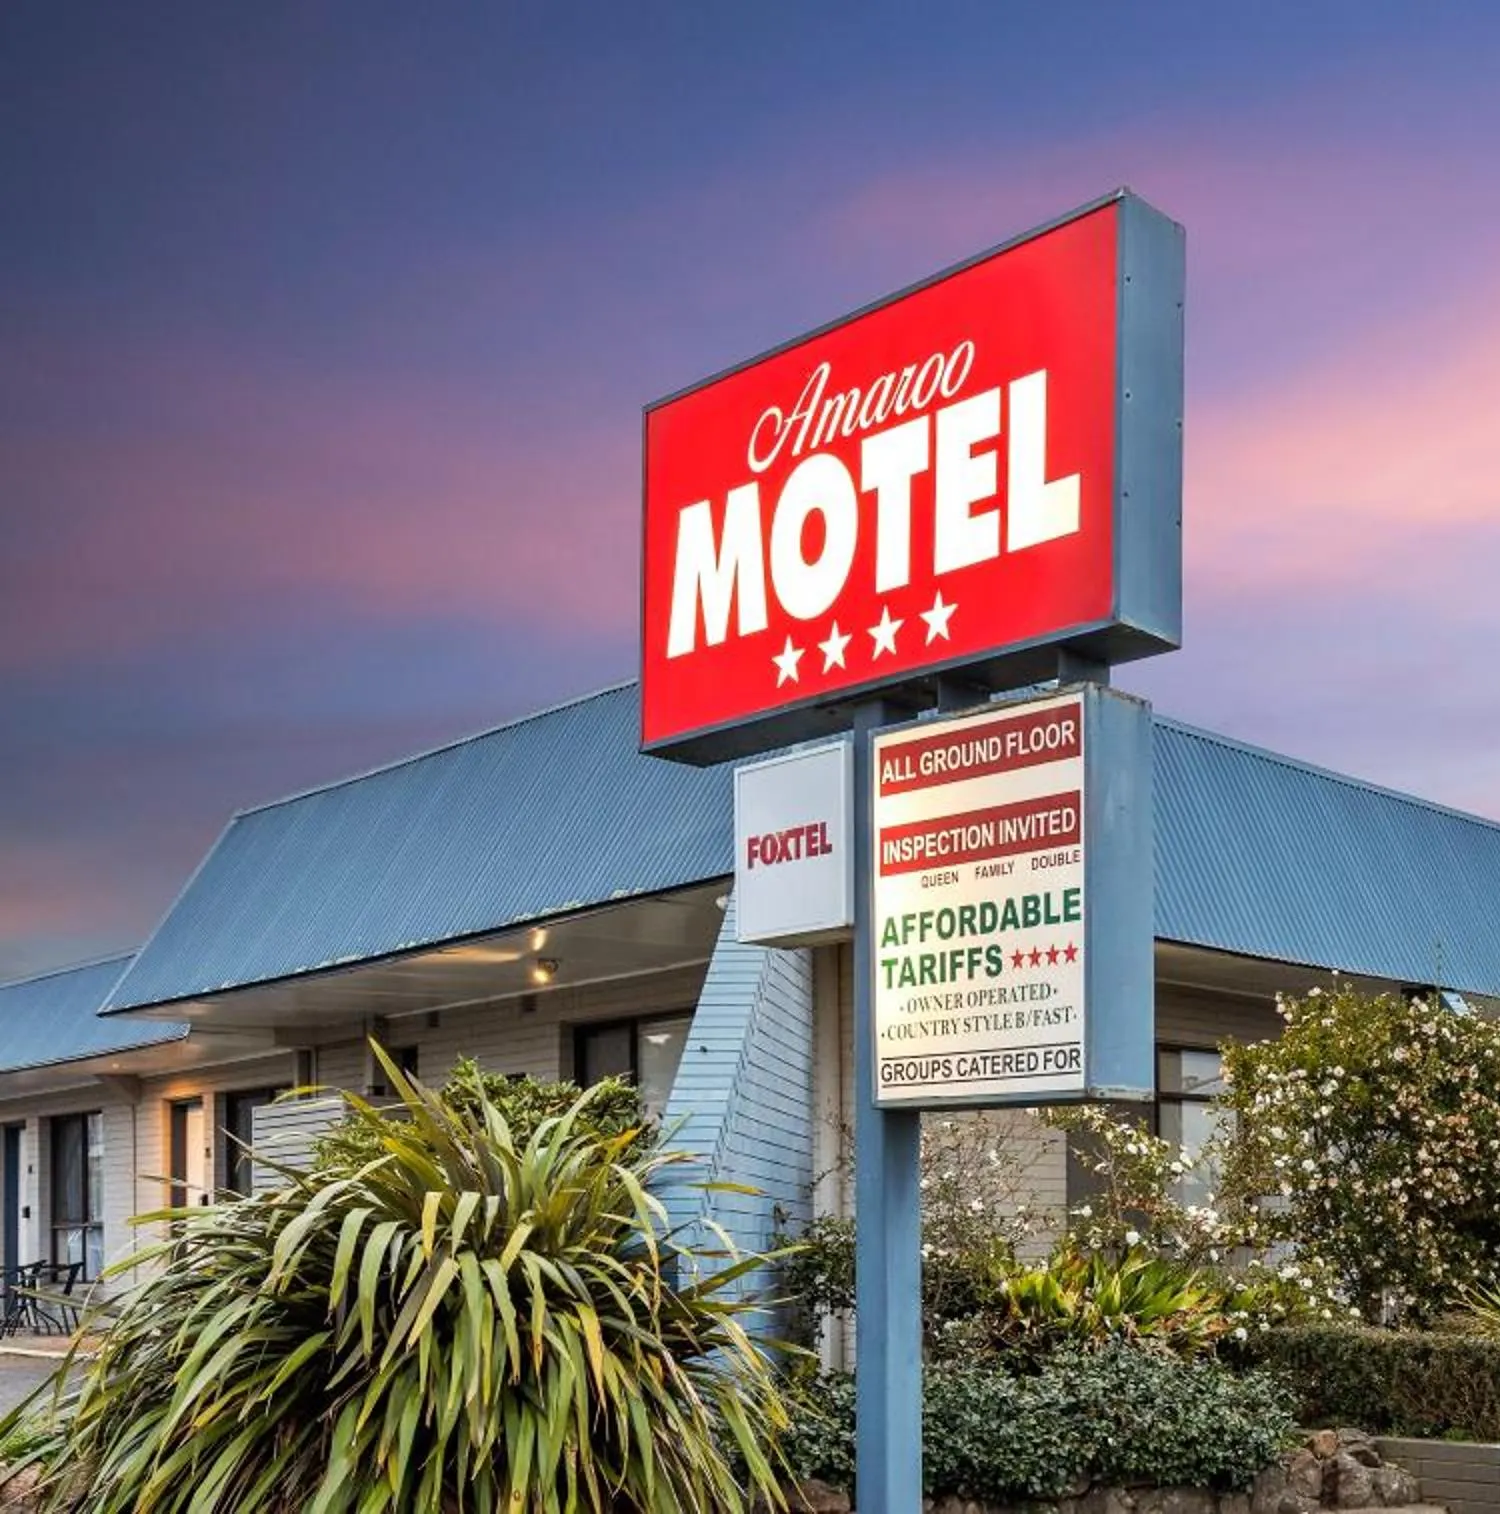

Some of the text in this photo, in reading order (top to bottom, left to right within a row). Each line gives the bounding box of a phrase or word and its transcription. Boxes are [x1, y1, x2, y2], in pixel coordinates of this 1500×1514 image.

[747, 341, 975, 472] Amaroo
[667, 369, 1080, 660] MOTEL
[881, 720, 1075, 784] ALL GROUND FLOOR
[747, 821, 832, 870] FOXTEL
[883, 807, 1076, 864] INSPECTION INVITED
[921, 850, 1081, 888] QUEEN FAMILY DOUBLE
[881, 887, 1081, 948] AFFORDABLE
[881, 944, 1003, 990] TARIFFS
[963, 1012, 1013, 1034] STYLE
[881, 1048, 1081, 1083] GROUPS CATERED FOR
